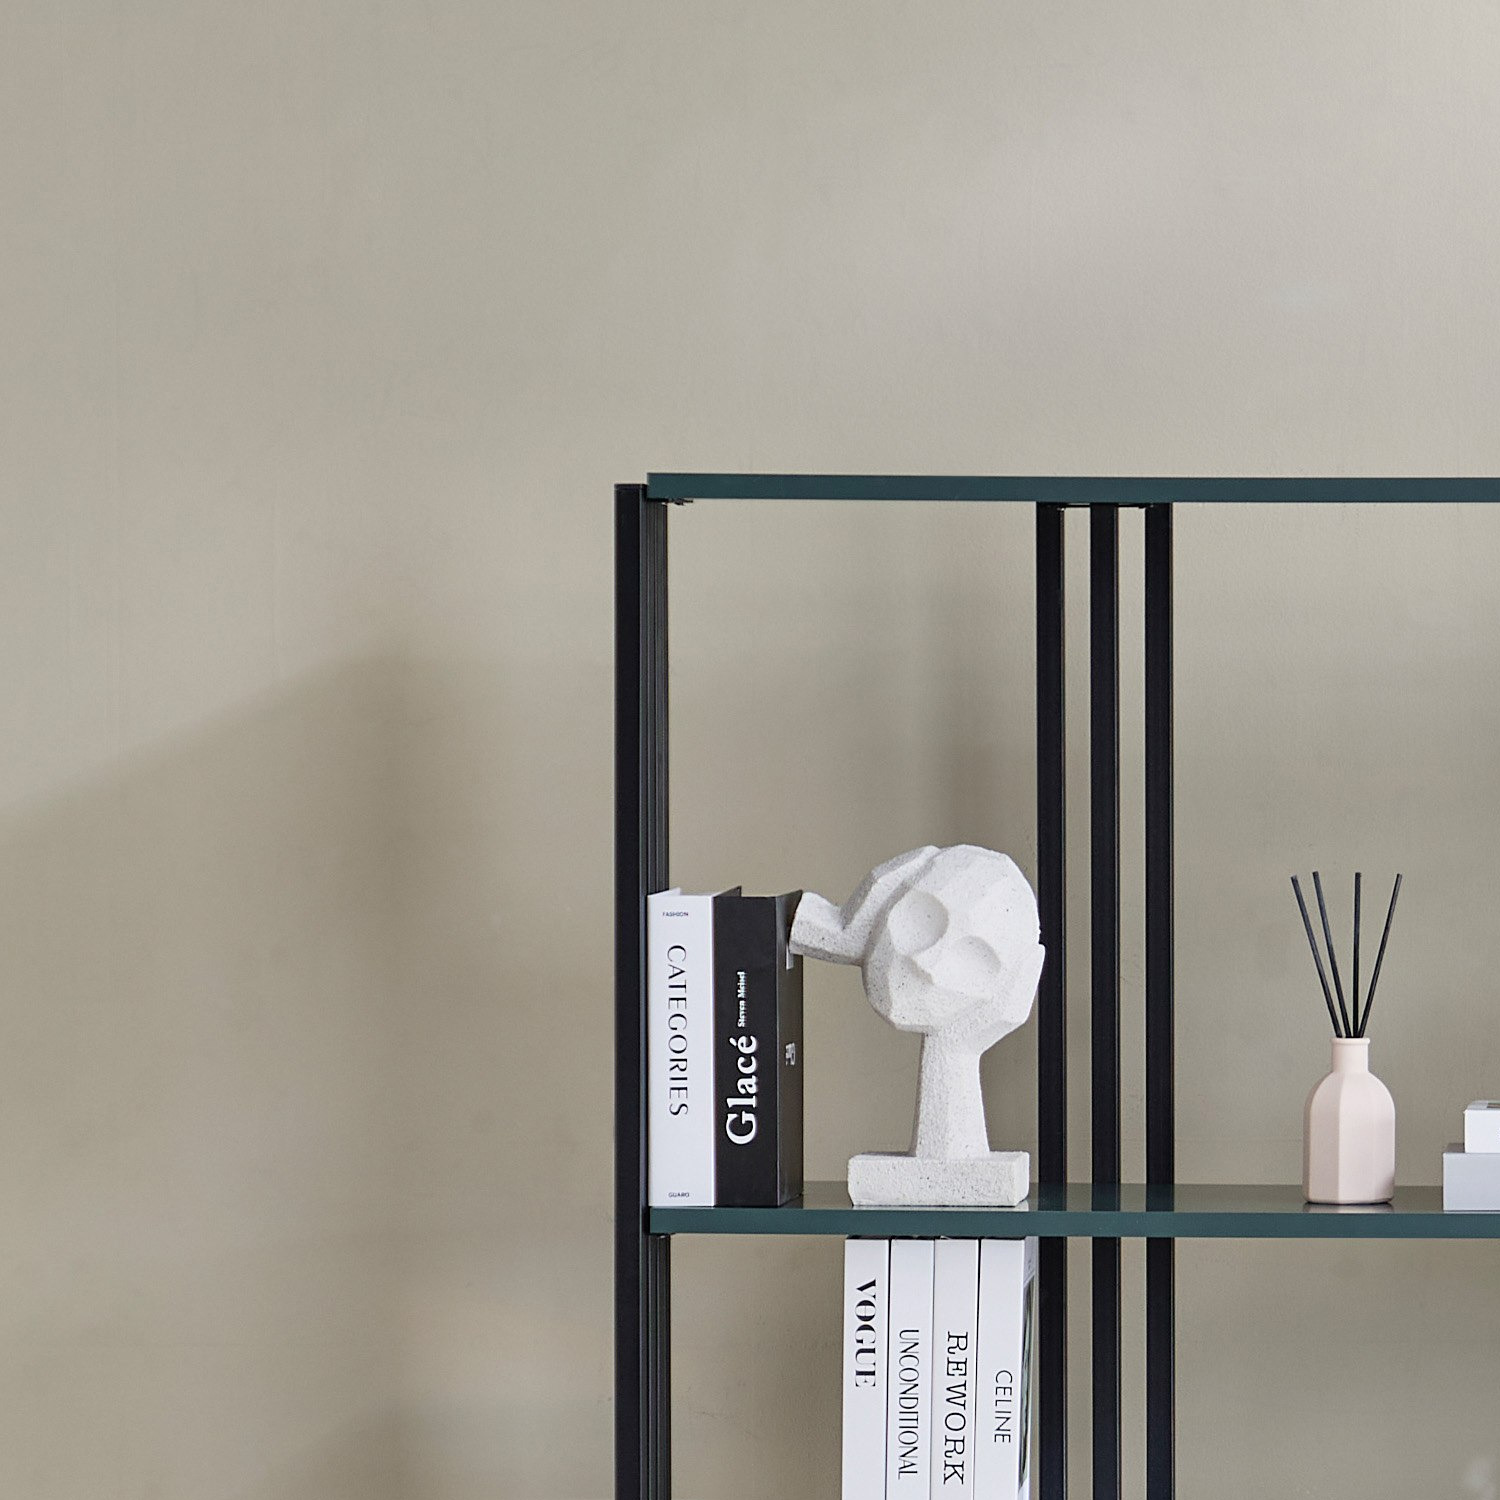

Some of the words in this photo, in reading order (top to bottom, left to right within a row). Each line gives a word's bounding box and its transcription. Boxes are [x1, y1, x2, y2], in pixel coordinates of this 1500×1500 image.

[667, 944, 689, 1116] CATEGORIES
[725, 1034, 758, 1145] Glacé
[855, 1279, 877, 1388] VOGUE
[898, 1329, 920, 1480] UNCONDITIONAL
[943, 1330, 969, 1485] REWORK
[993, 1370, 1013, 1444] CELINE
